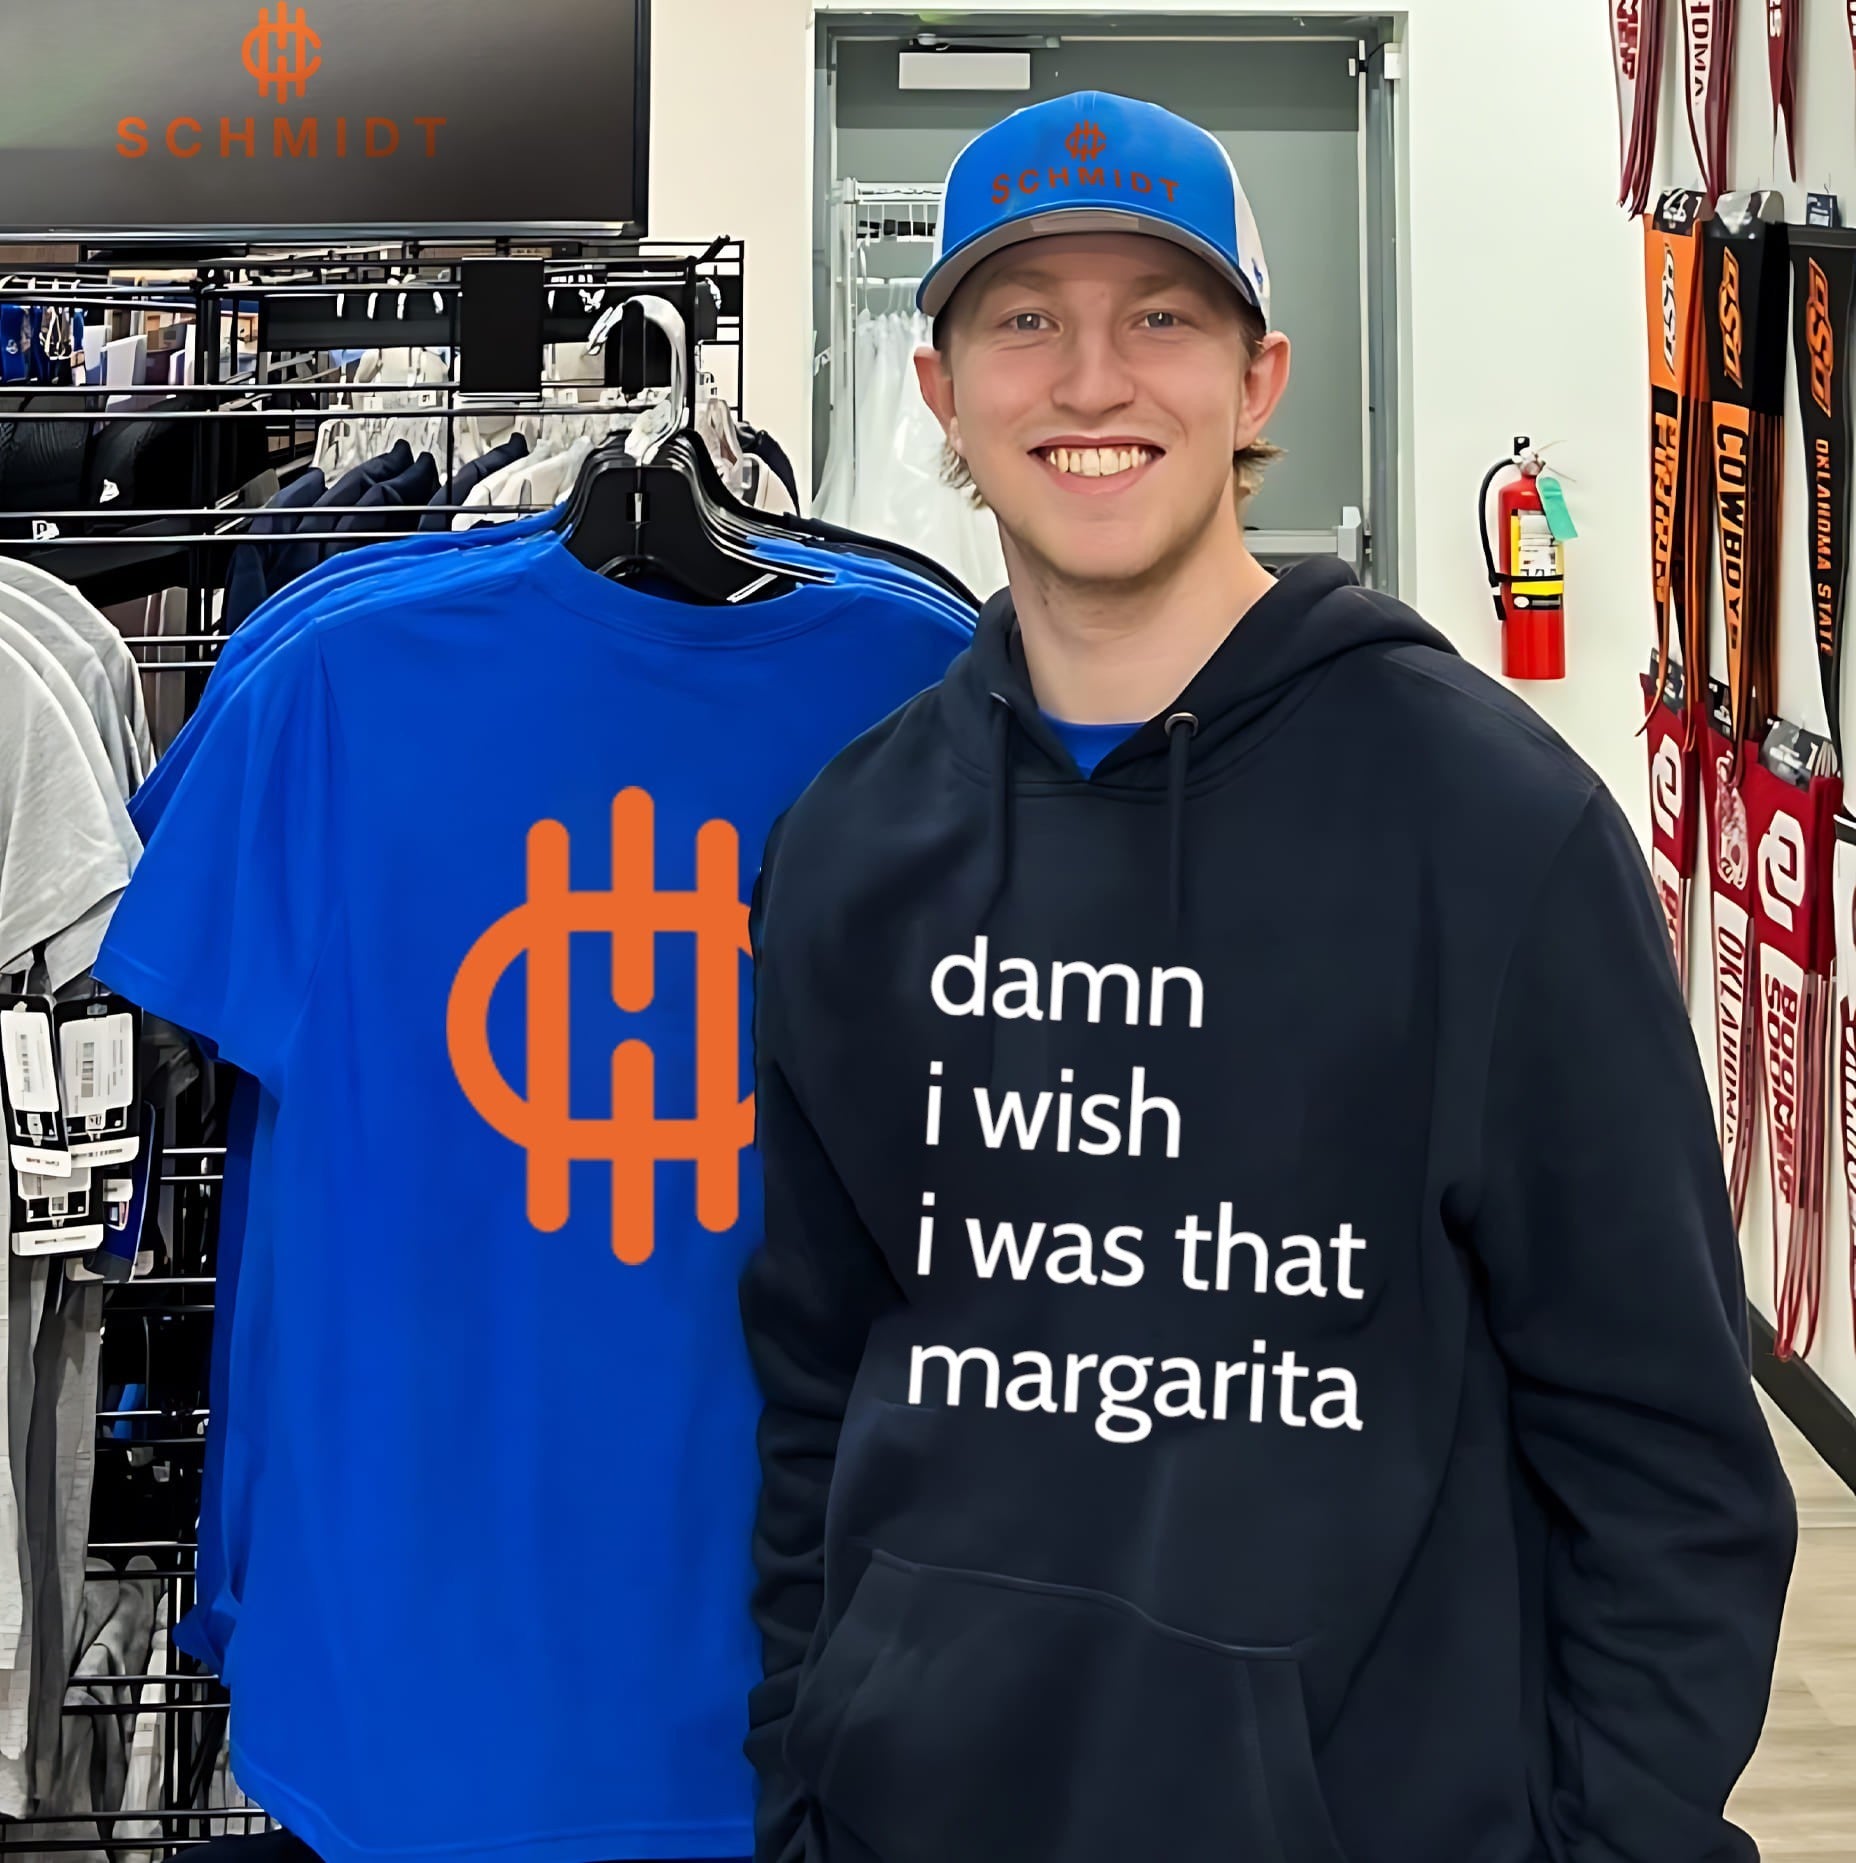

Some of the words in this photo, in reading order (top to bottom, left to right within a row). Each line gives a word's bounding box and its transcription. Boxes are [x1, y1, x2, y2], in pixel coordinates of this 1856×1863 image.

[116, 116, 446, 158] SCHMIDT
[991, 166, 1179, 205] SCHMIDT
[1815, 438, 1832, 570] OKLAHOMA
[931, 936, 1204, 1028] damn
[926, 1061, 943, 1146] i
[973, 1066, 1181, 1158] wish
[917, 1192, 936, 1276] i
[965, 1218, 1145, 1287] was
[1174, 1201, 1367, 1300] that
[908, 1340, 1364, 1444] margarita
